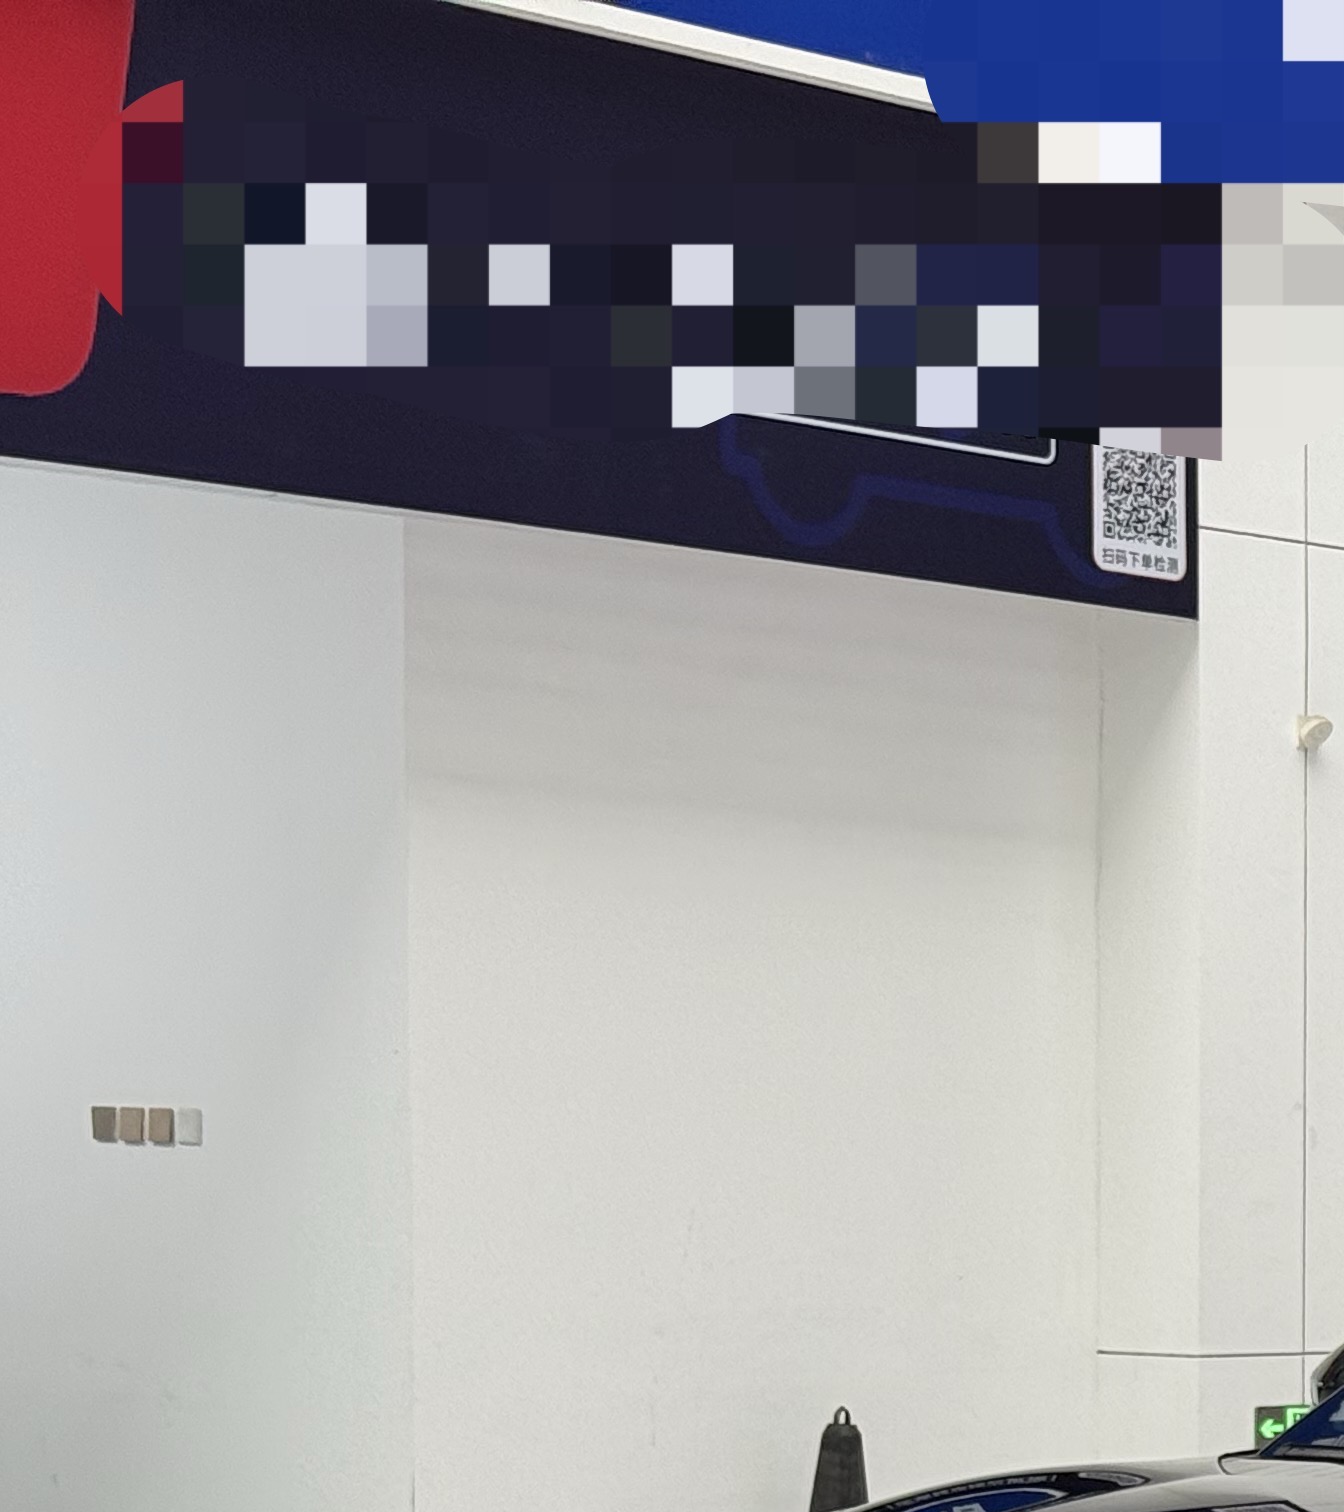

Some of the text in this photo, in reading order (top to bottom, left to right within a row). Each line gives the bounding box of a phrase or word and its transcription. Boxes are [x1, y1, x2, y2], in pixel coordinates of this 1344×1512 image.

[1102, 548, 1179, 574] 扫码下单检测
